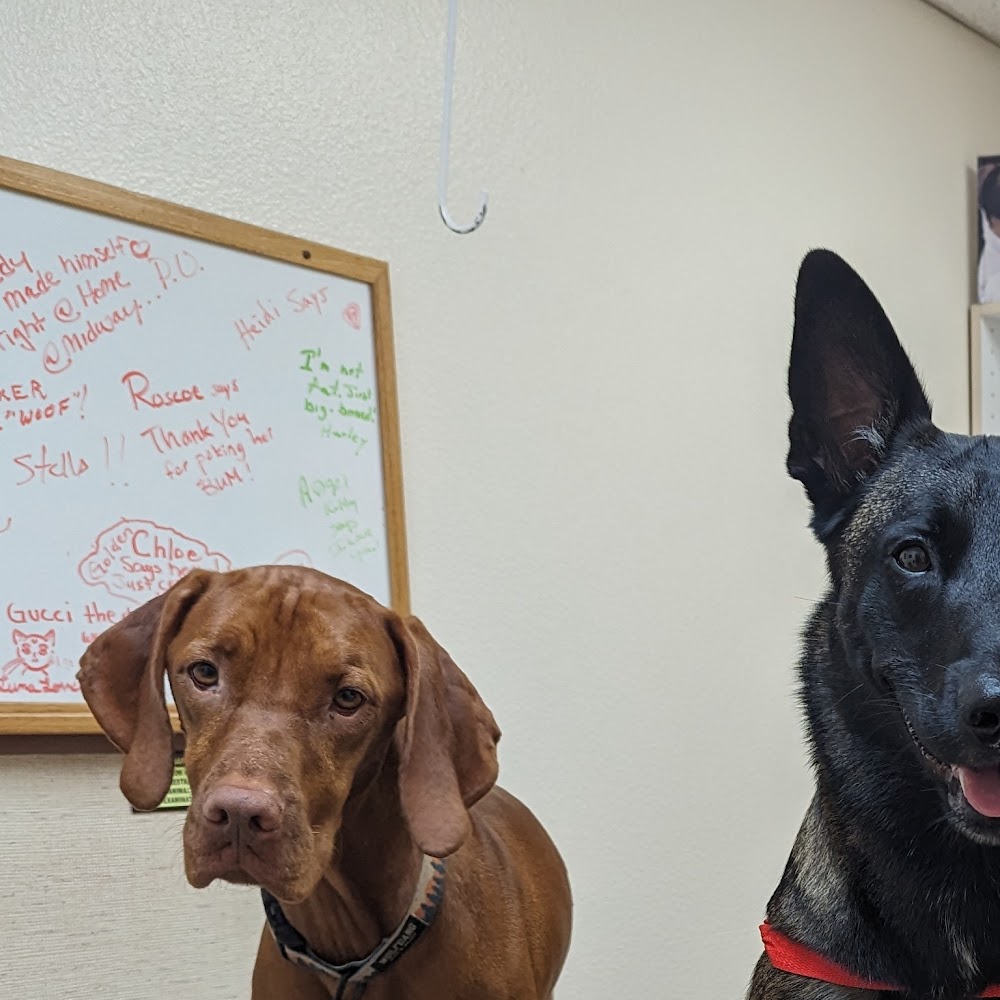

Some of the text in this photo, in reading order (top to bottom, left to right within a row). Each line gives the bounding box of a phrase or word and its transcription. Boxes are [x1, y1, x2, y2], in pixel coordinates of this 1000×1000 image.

[3, 233, 130, 312] made himself
[54, 297, 81, 323] @
[77, 270, 131, 307] Home
[234, 298, 281, 351] Heidi
[121, 371, 204, 411] Roscoe
[140, 407, 250, 455] Thank You
[163, 459, 188, 480] for
[131, 528, 202, 562] Chloe
[120, 555, 163, 582] Says
[6, 601, 73, 624] Gucci
[83, 601, 118, 625] the
